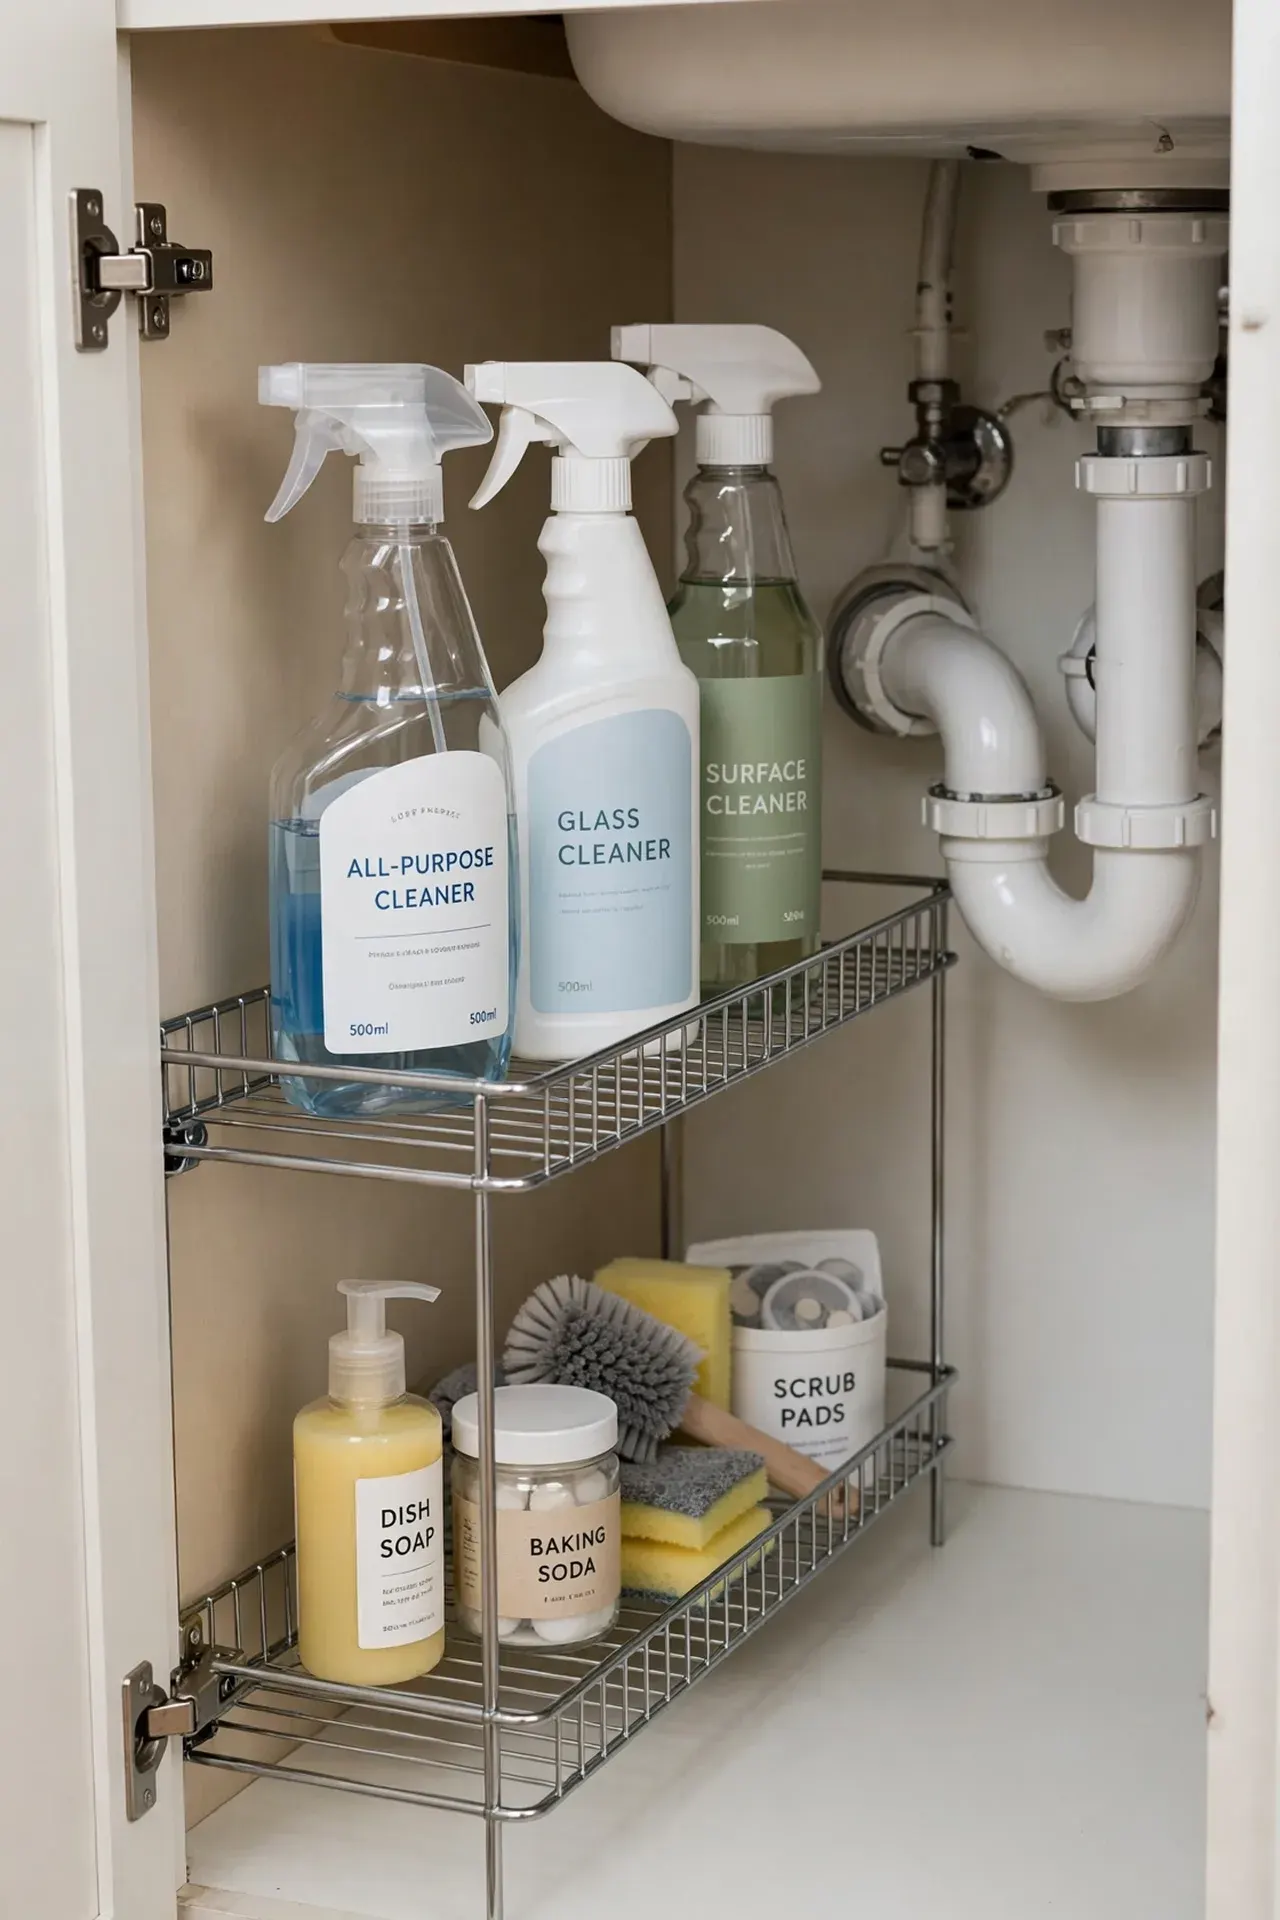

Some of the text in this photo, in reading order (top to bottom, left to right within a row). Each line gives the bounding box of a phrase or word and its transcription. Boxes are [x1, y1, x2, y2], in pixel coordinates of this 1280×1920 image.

[706, 759, 806, 784] SURFACE
[706, 790, 807, 815] CLEANER
[557, 808, 640, 832] GLASS
[347, 846, 494, 878] ALL-PURPOSE
[558, 838, 671, 866] CLEANER
[374, 882, 475, 910] CLEANER
[706, 914, 739, 926] 500ml
[350, 1022, 389, 1037] 500ml
[469, 1007, 497, 1025] 500ml
[774, 1371, 856, 1398] SCRUB
[781, 1402, 845, 1428] PADS
[381, 1498, 430, 1528] DISH
[380, 1526, 435, 1559] SOAP
[530, 1525, 606, 1556] BAKING
[538, 1556, 596, 1583] SODA
